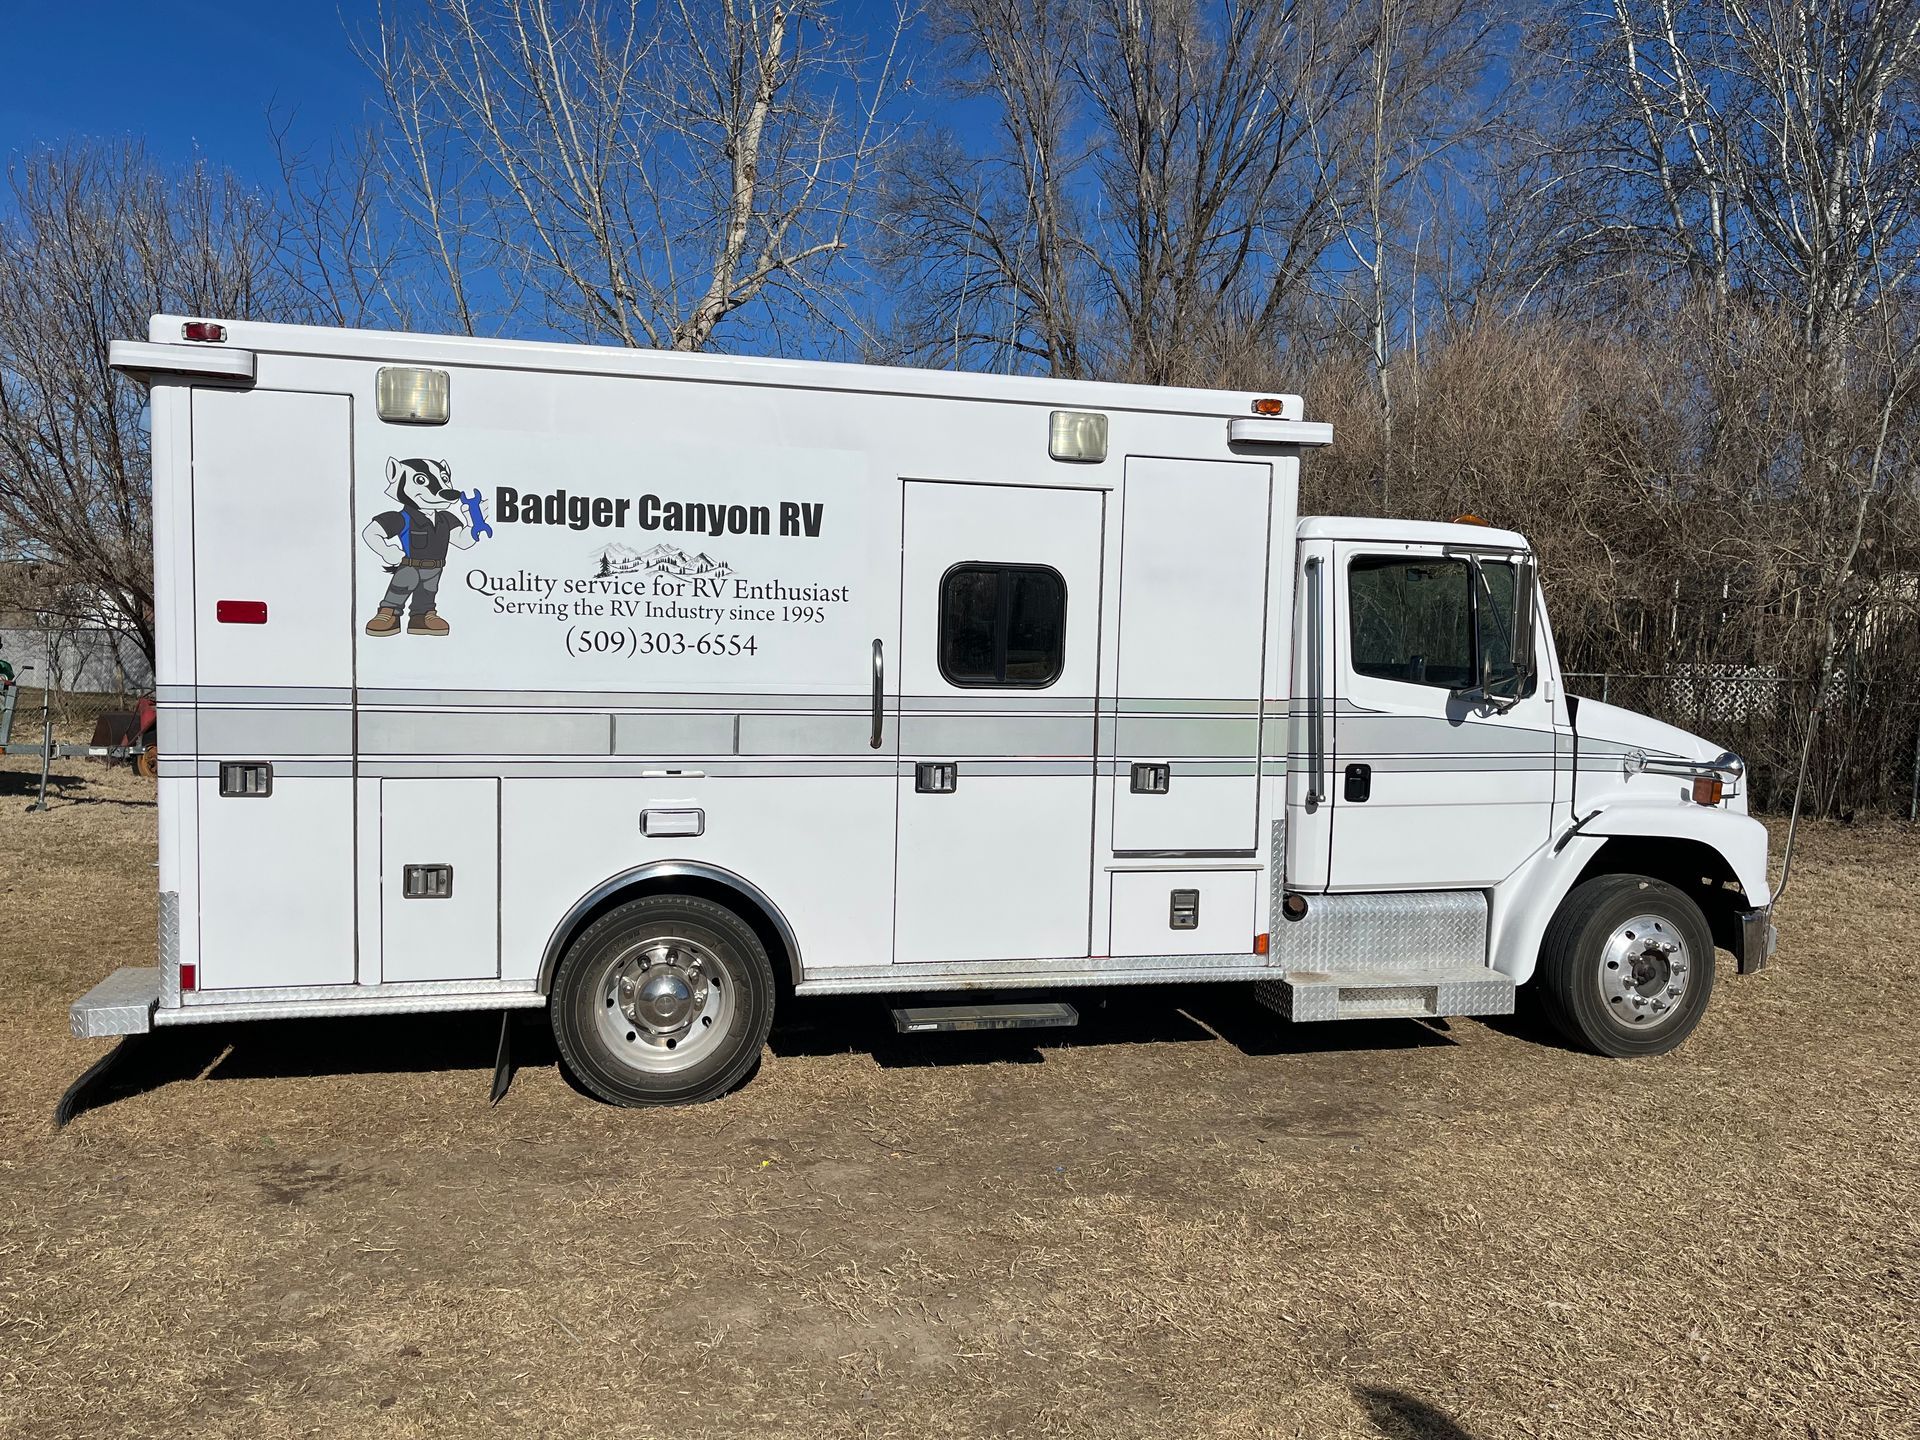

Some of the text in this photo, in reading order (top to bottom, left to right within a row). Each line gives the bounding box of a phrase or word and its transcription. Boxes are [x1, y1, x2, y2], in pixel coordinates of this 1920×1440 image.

[496, 486, 824, 538] Badger Canyon RV
[465, 569, 850, 603] Quality service for RV Enthusiast
[493, 596, 825, 626] Serving the RV Industry since 1995
[565, 626, 758, 658] (509)303-6554
